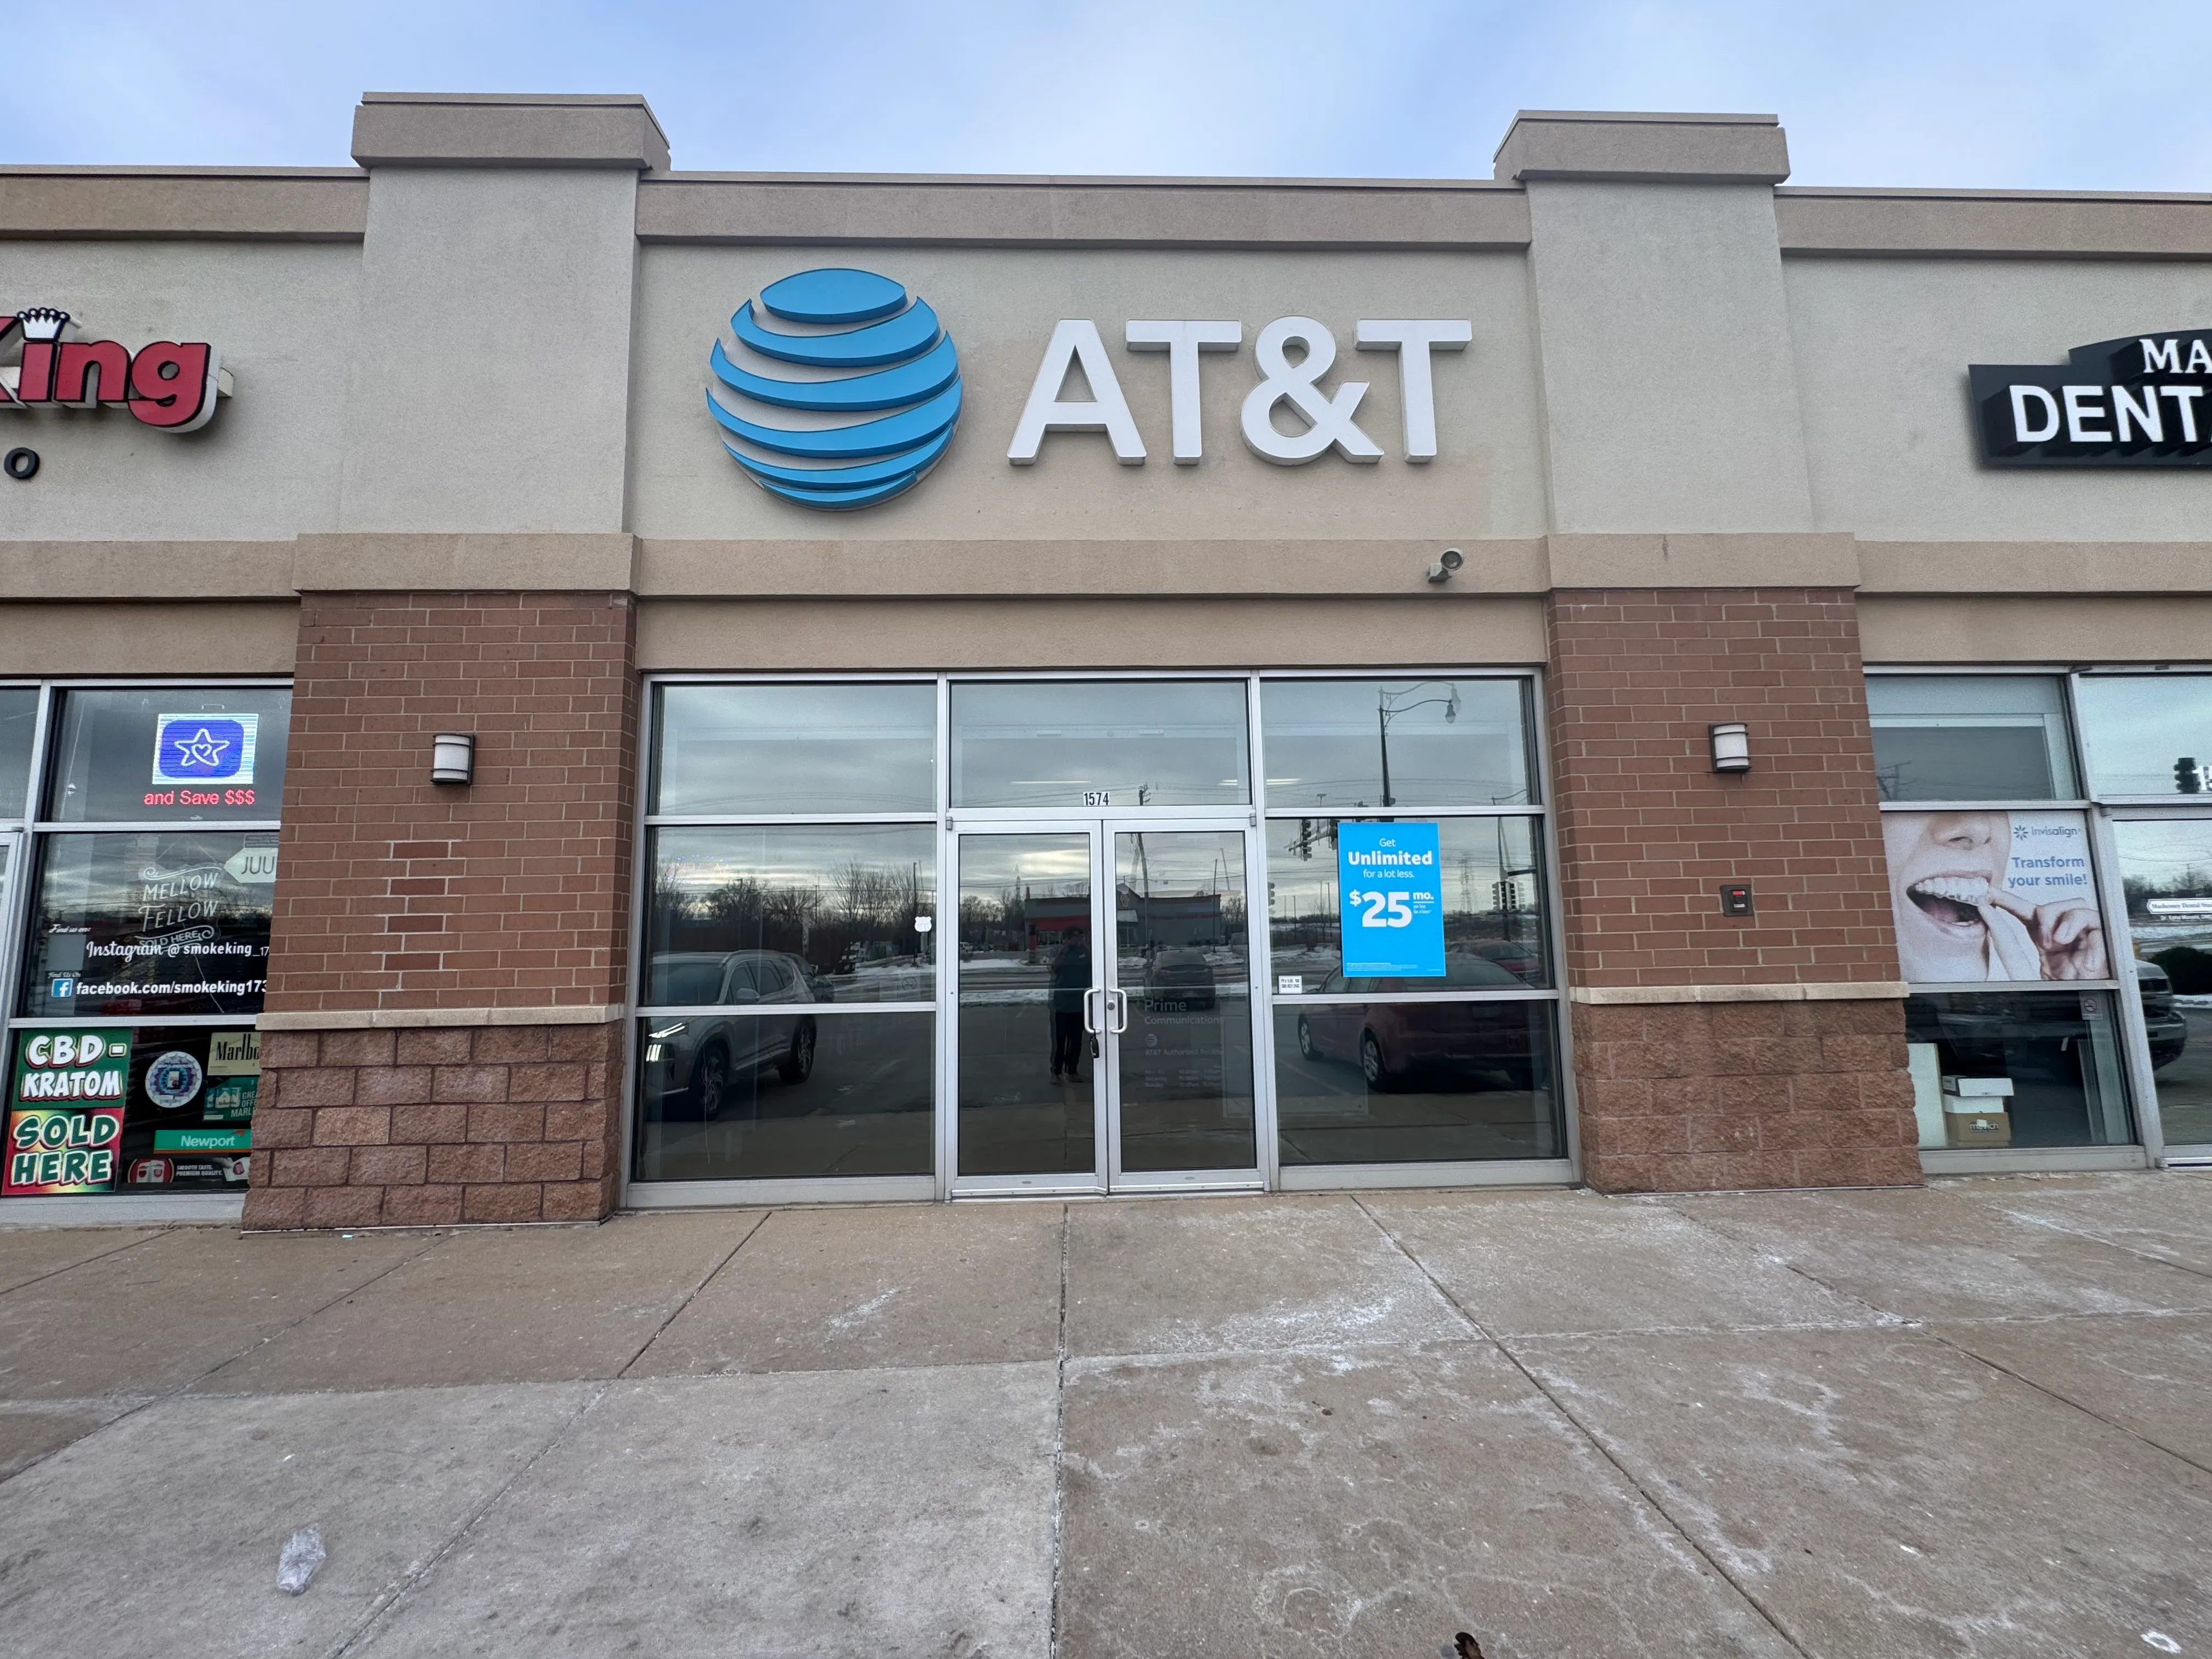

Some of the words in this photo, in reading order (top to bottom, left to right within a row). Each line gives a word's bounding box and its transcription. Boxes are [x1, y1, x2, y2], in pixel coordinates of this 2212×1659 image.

[2138, 338, 2212, 373] MA
[1007, 315, 1471, 465] AT&T
[2009, 385, 2212, 442] DENT
[144, 791, 174, 805] and
[179, 790, 219, 805] Save
[224, 789, 255, 805] $$$
[1084, 792, 1109, 806] 1574
[1379, 838, 1396, 848] Get
[1348, 850, 1432, 865] Unlimited
[2012, 857, 2085, 868] Transform
[1363, 869, 1376, 878] for
[1384, 869, 1396, 878] lot
[1397, 869, 1415, 878] less.
[2008, 877, 2040, 889] your
[2045, 873, 2088, 885] smile!
[142, 872, 219, 901] MELLOW
[1413, 891, 1435, 900] mo.
[138, 900, 219, 933] FELLOW
[139, 937, 168, 946] SOLD
[171, 930, 199, 944] HERE
[86, 941, 163, 962] Instagram
[168, 944, 180, 957] @
[183, 941, 269, 957] smokeking_17
[1144, 999, 1187, 1012] Prime
[1144, 1016, 1224, 1025] Communications
[21, 1070, 122, 1099] KRATOM
[14, 1115, 119, 1149] SOLD
[180, 1135, 235, 1149] Newport
[11, 1150, 113, 1185] HERE
